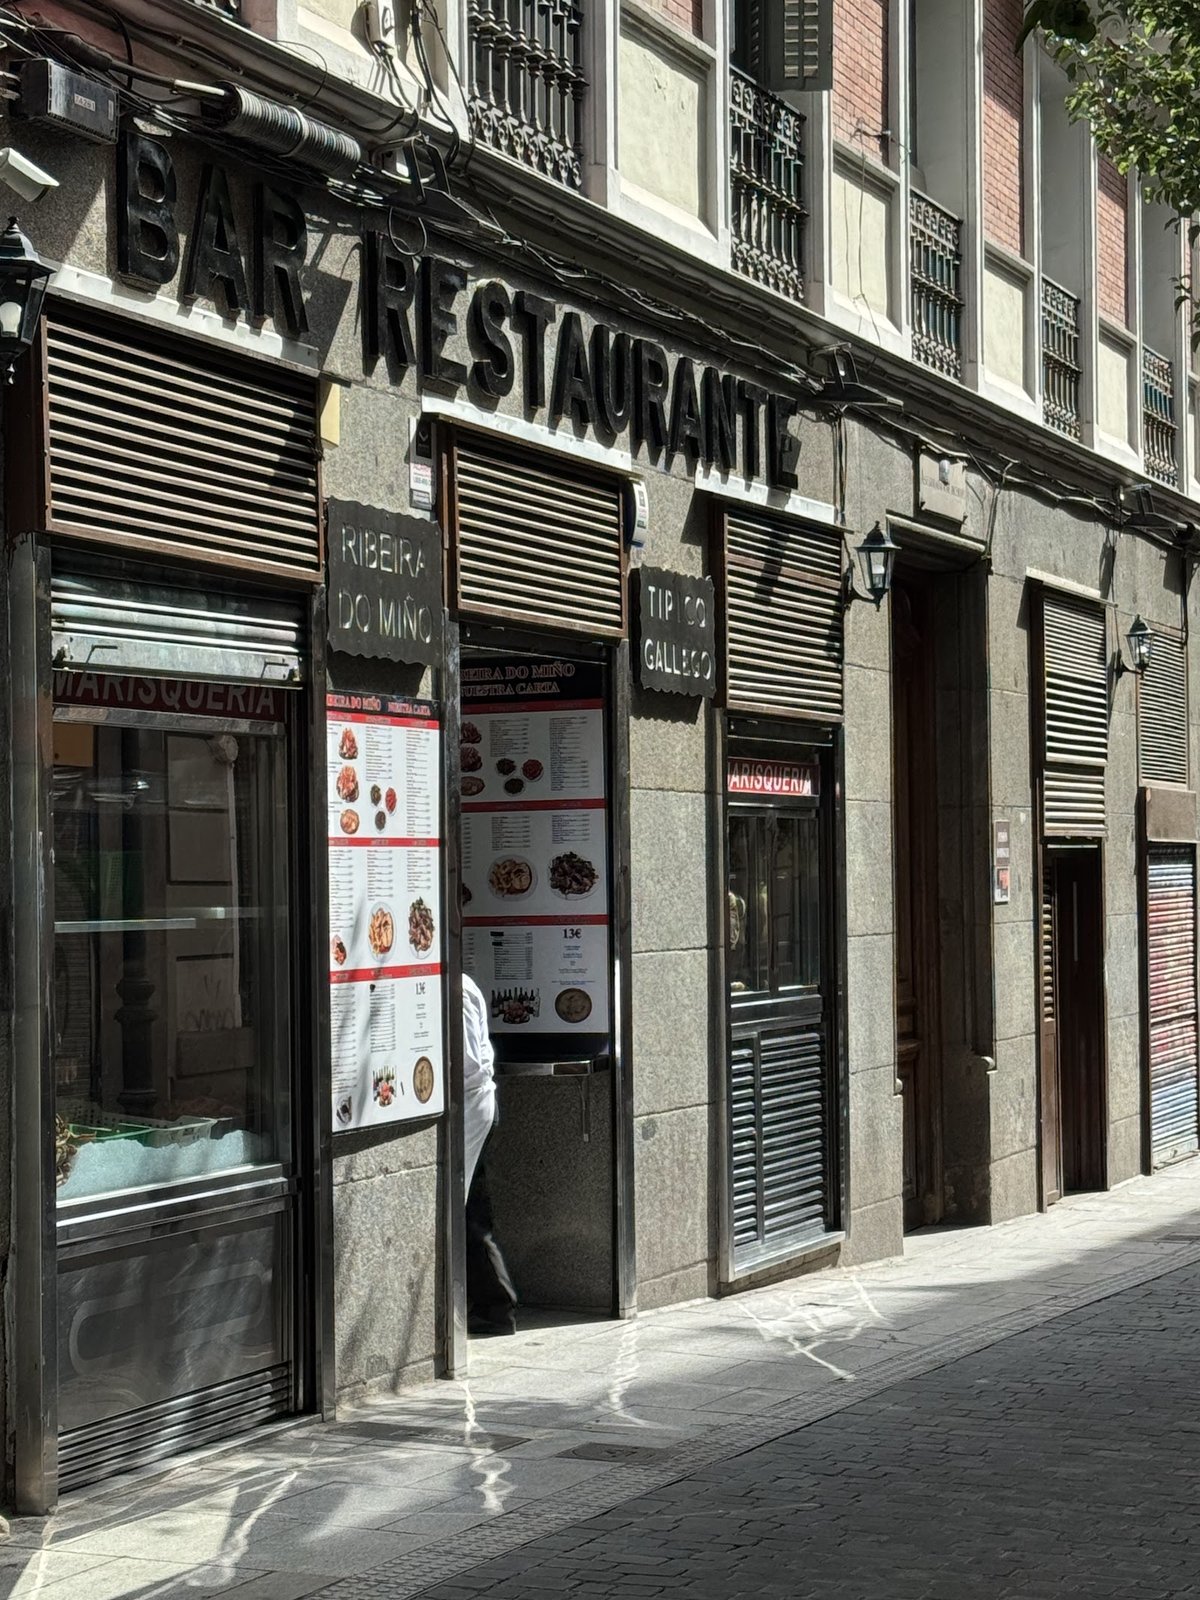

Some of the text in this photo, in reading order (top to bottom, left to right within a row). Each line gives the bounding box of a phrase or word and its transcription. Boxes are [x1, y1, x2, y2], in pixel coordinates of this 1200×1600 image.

[116, 128, 801, 490] BAR RESTAURANTE
[342, 522, 426, 578] RIBEIRA
[338, 587, 433, 644] DO MIÑO
[505, 665, 529, 680] DO
[531, 661, 576, 678] MIÑO
[643, 638, 712, 681] GALLEGO
[516, 681, 561, 695] CARTA
[563, 928, 582, 939] 13€
